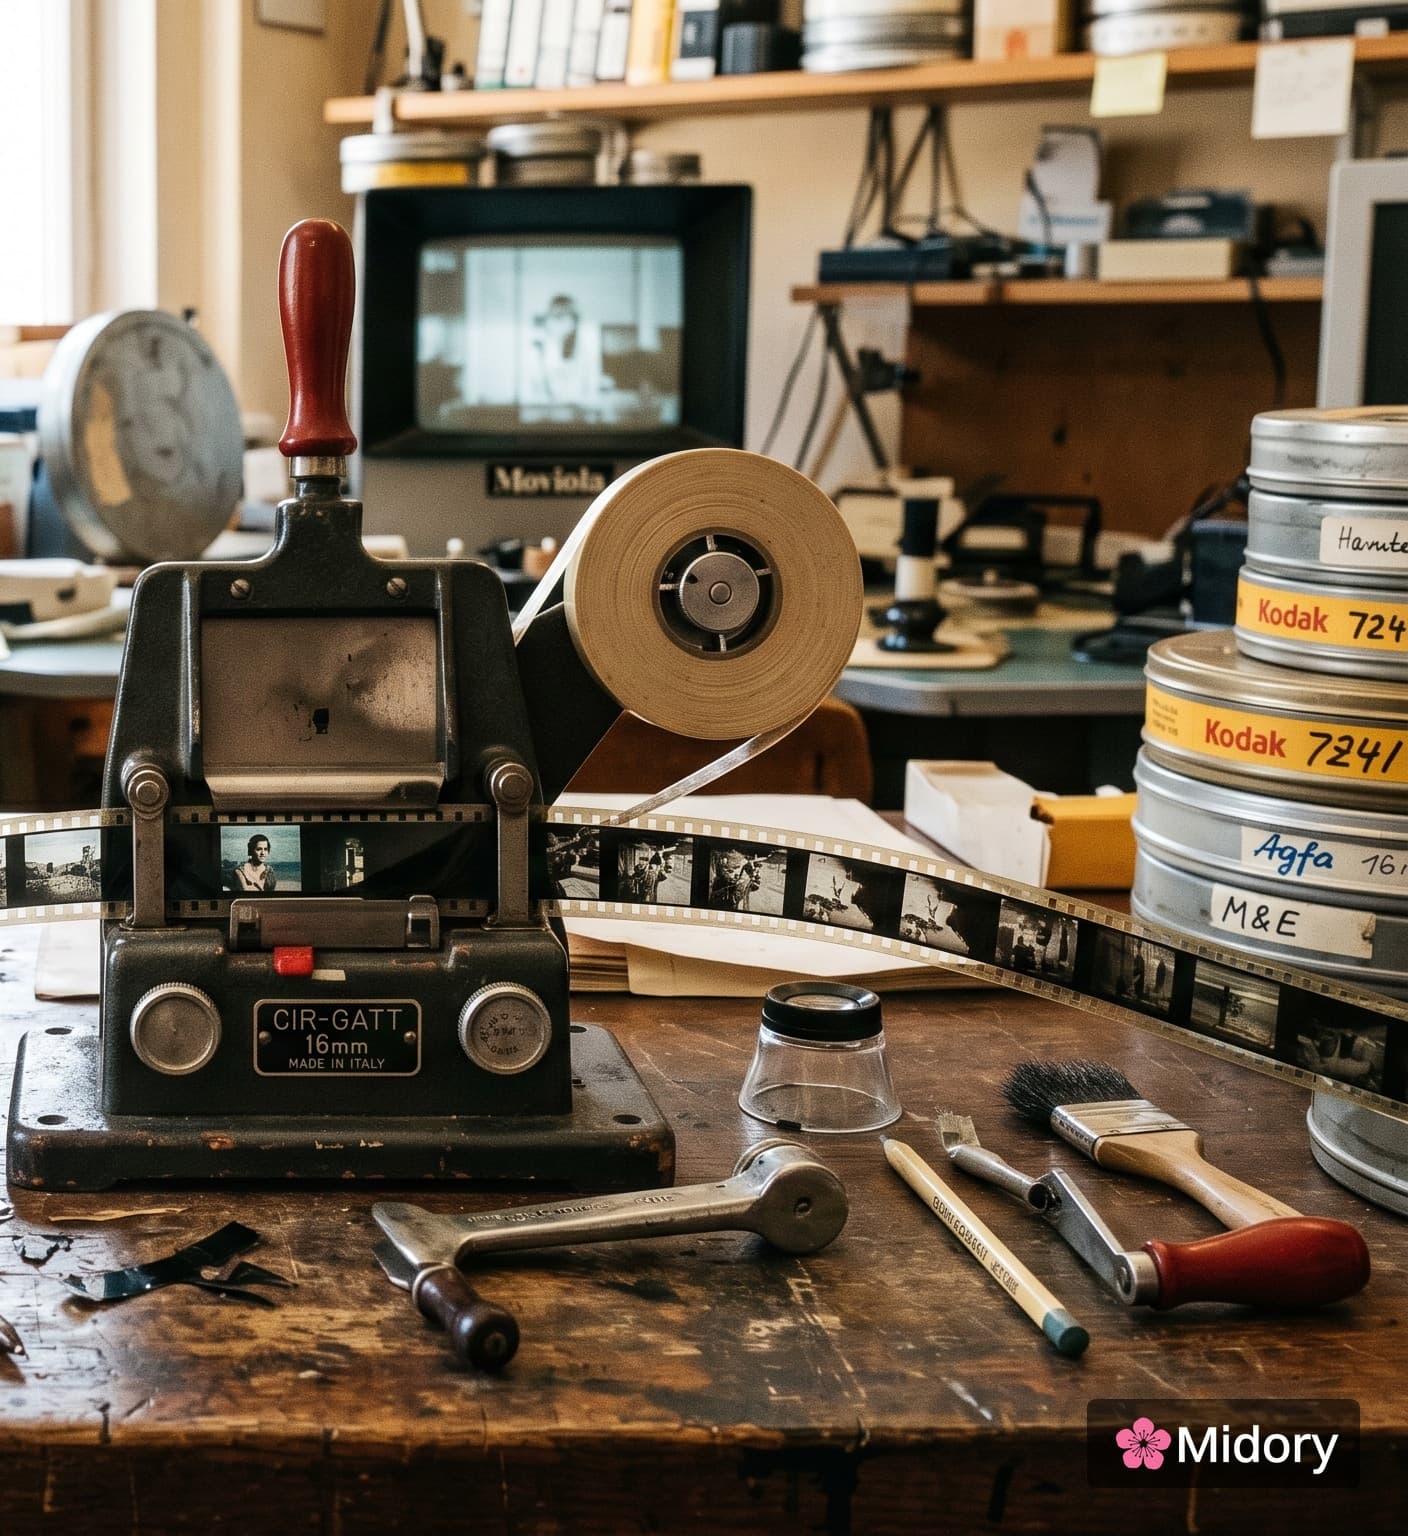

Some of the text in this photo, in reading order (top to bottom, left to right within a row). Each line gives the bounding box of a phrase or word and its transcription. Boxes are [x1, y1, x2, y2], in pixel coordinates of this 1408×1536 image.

[494, 463, 607, 494] Moviola
[1258, 598, 1329, 633] Kodak
[1205, 717, 1287, 758] Kodak
[1307, 731, 1404, 773] 7241
[1254, 834, 1334, 877] Agfa
[1221, 895, 1300, 937] M&E
[273, 1008, 403, 1031] CIR-GATT
[305, 1033, 368, 1054] 16mm
[288, 1058, 385, 1069] MADE IN ITALY
